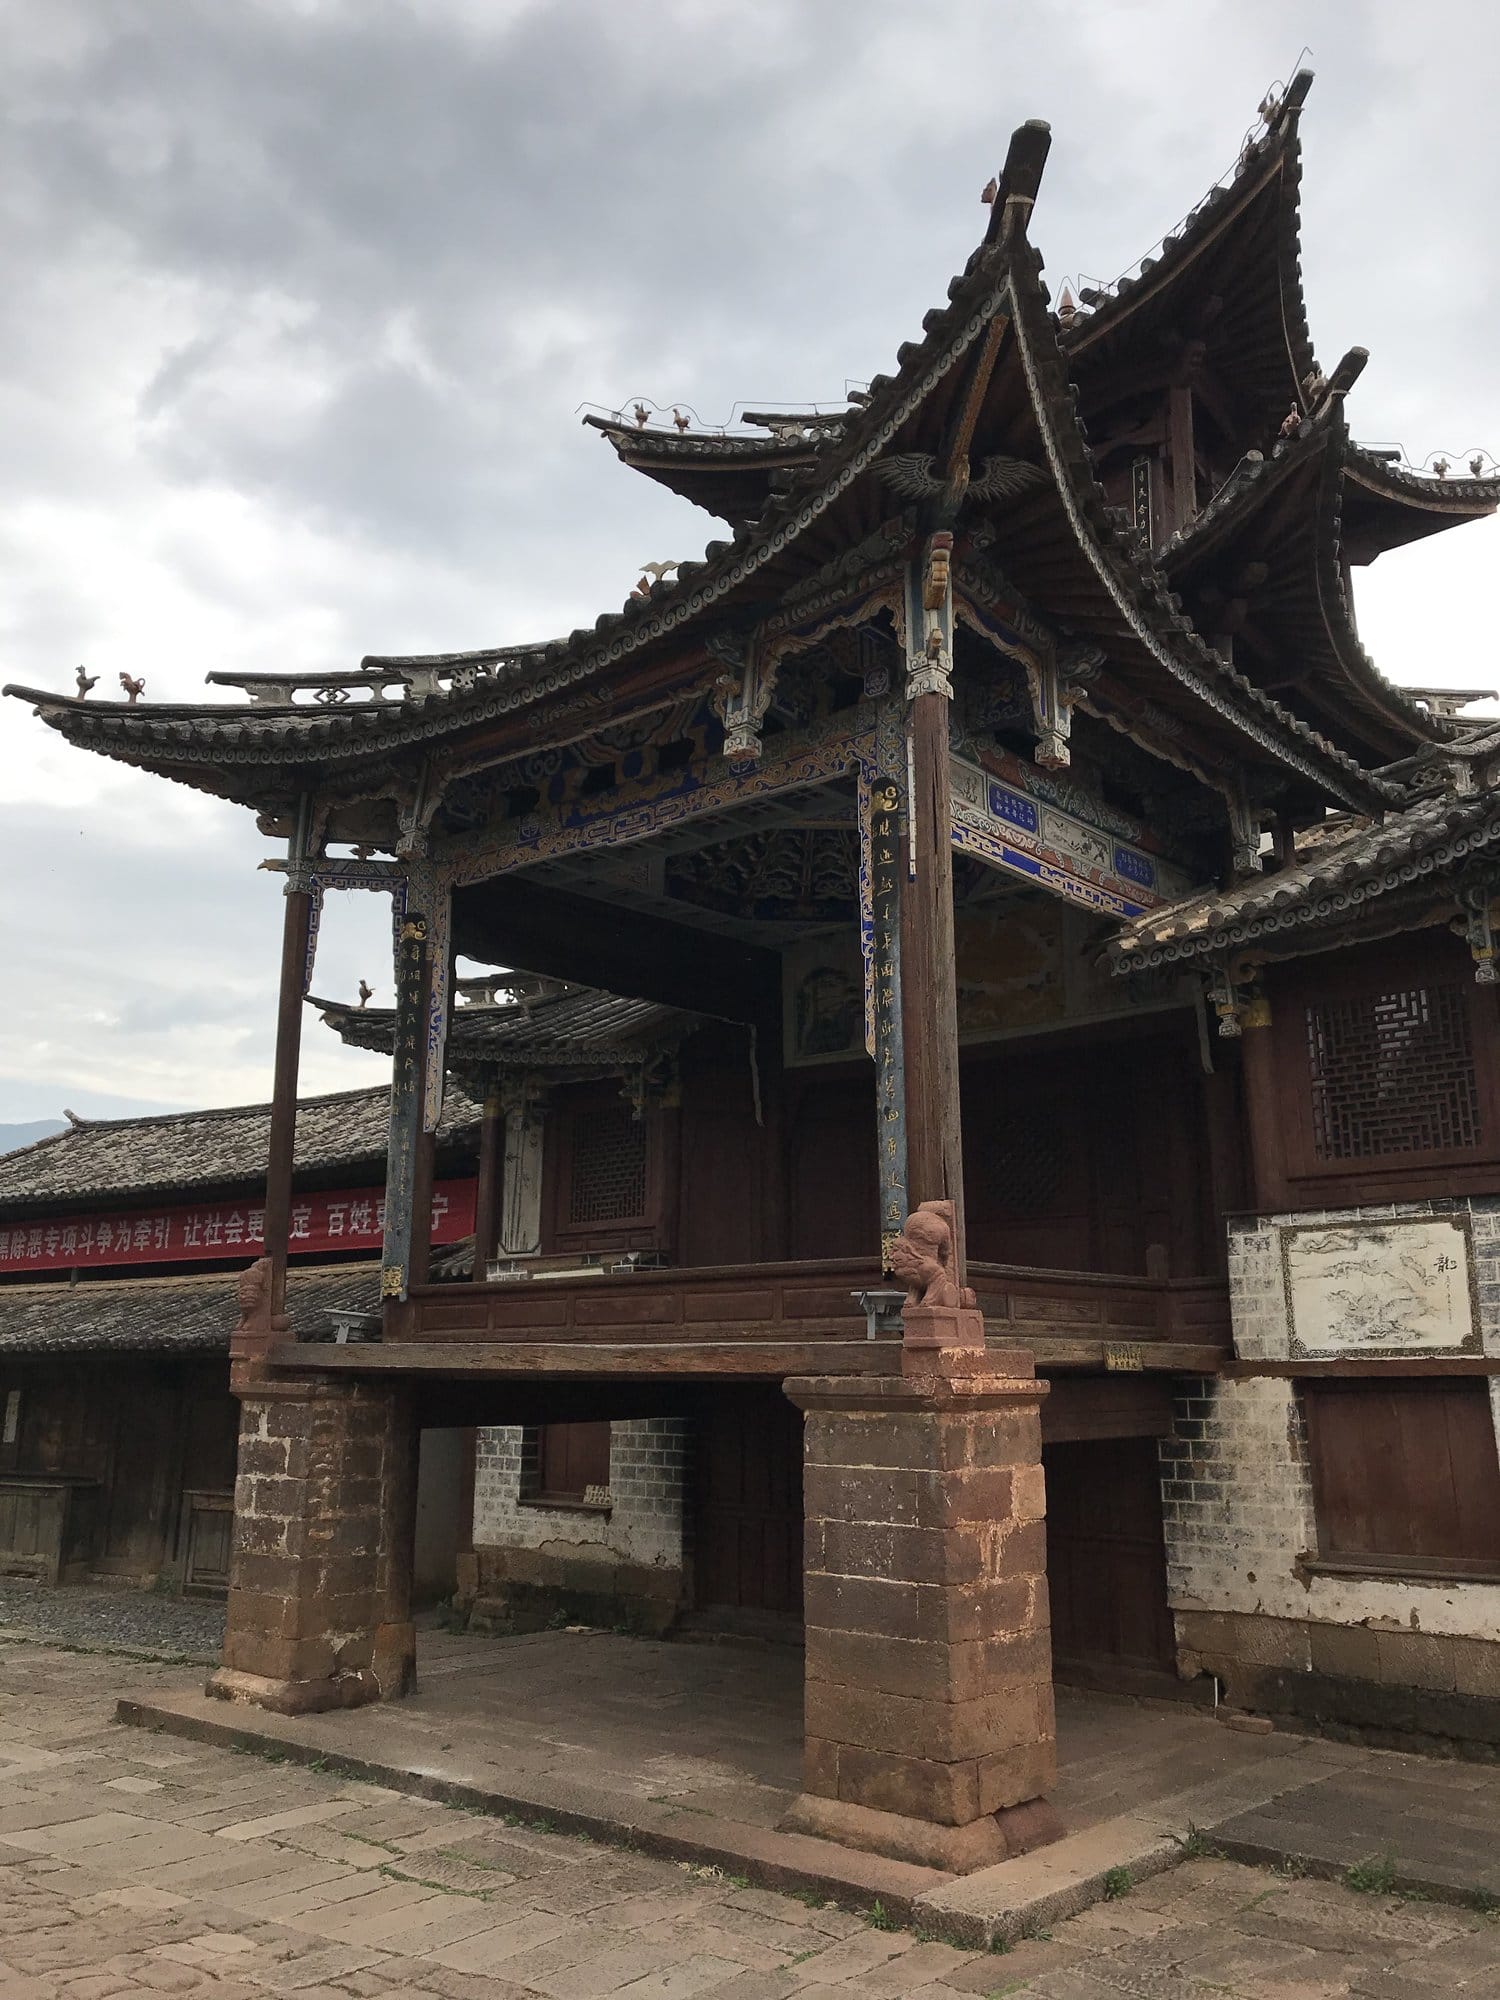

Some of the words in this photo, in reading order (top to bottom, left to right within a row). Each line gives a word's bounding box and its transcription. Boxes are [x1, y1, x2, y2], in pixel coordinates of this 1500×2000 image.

[183, 1204, 312, 1248] 让社会更定
[327, 1192, 449, 1237] 百姓更宁
